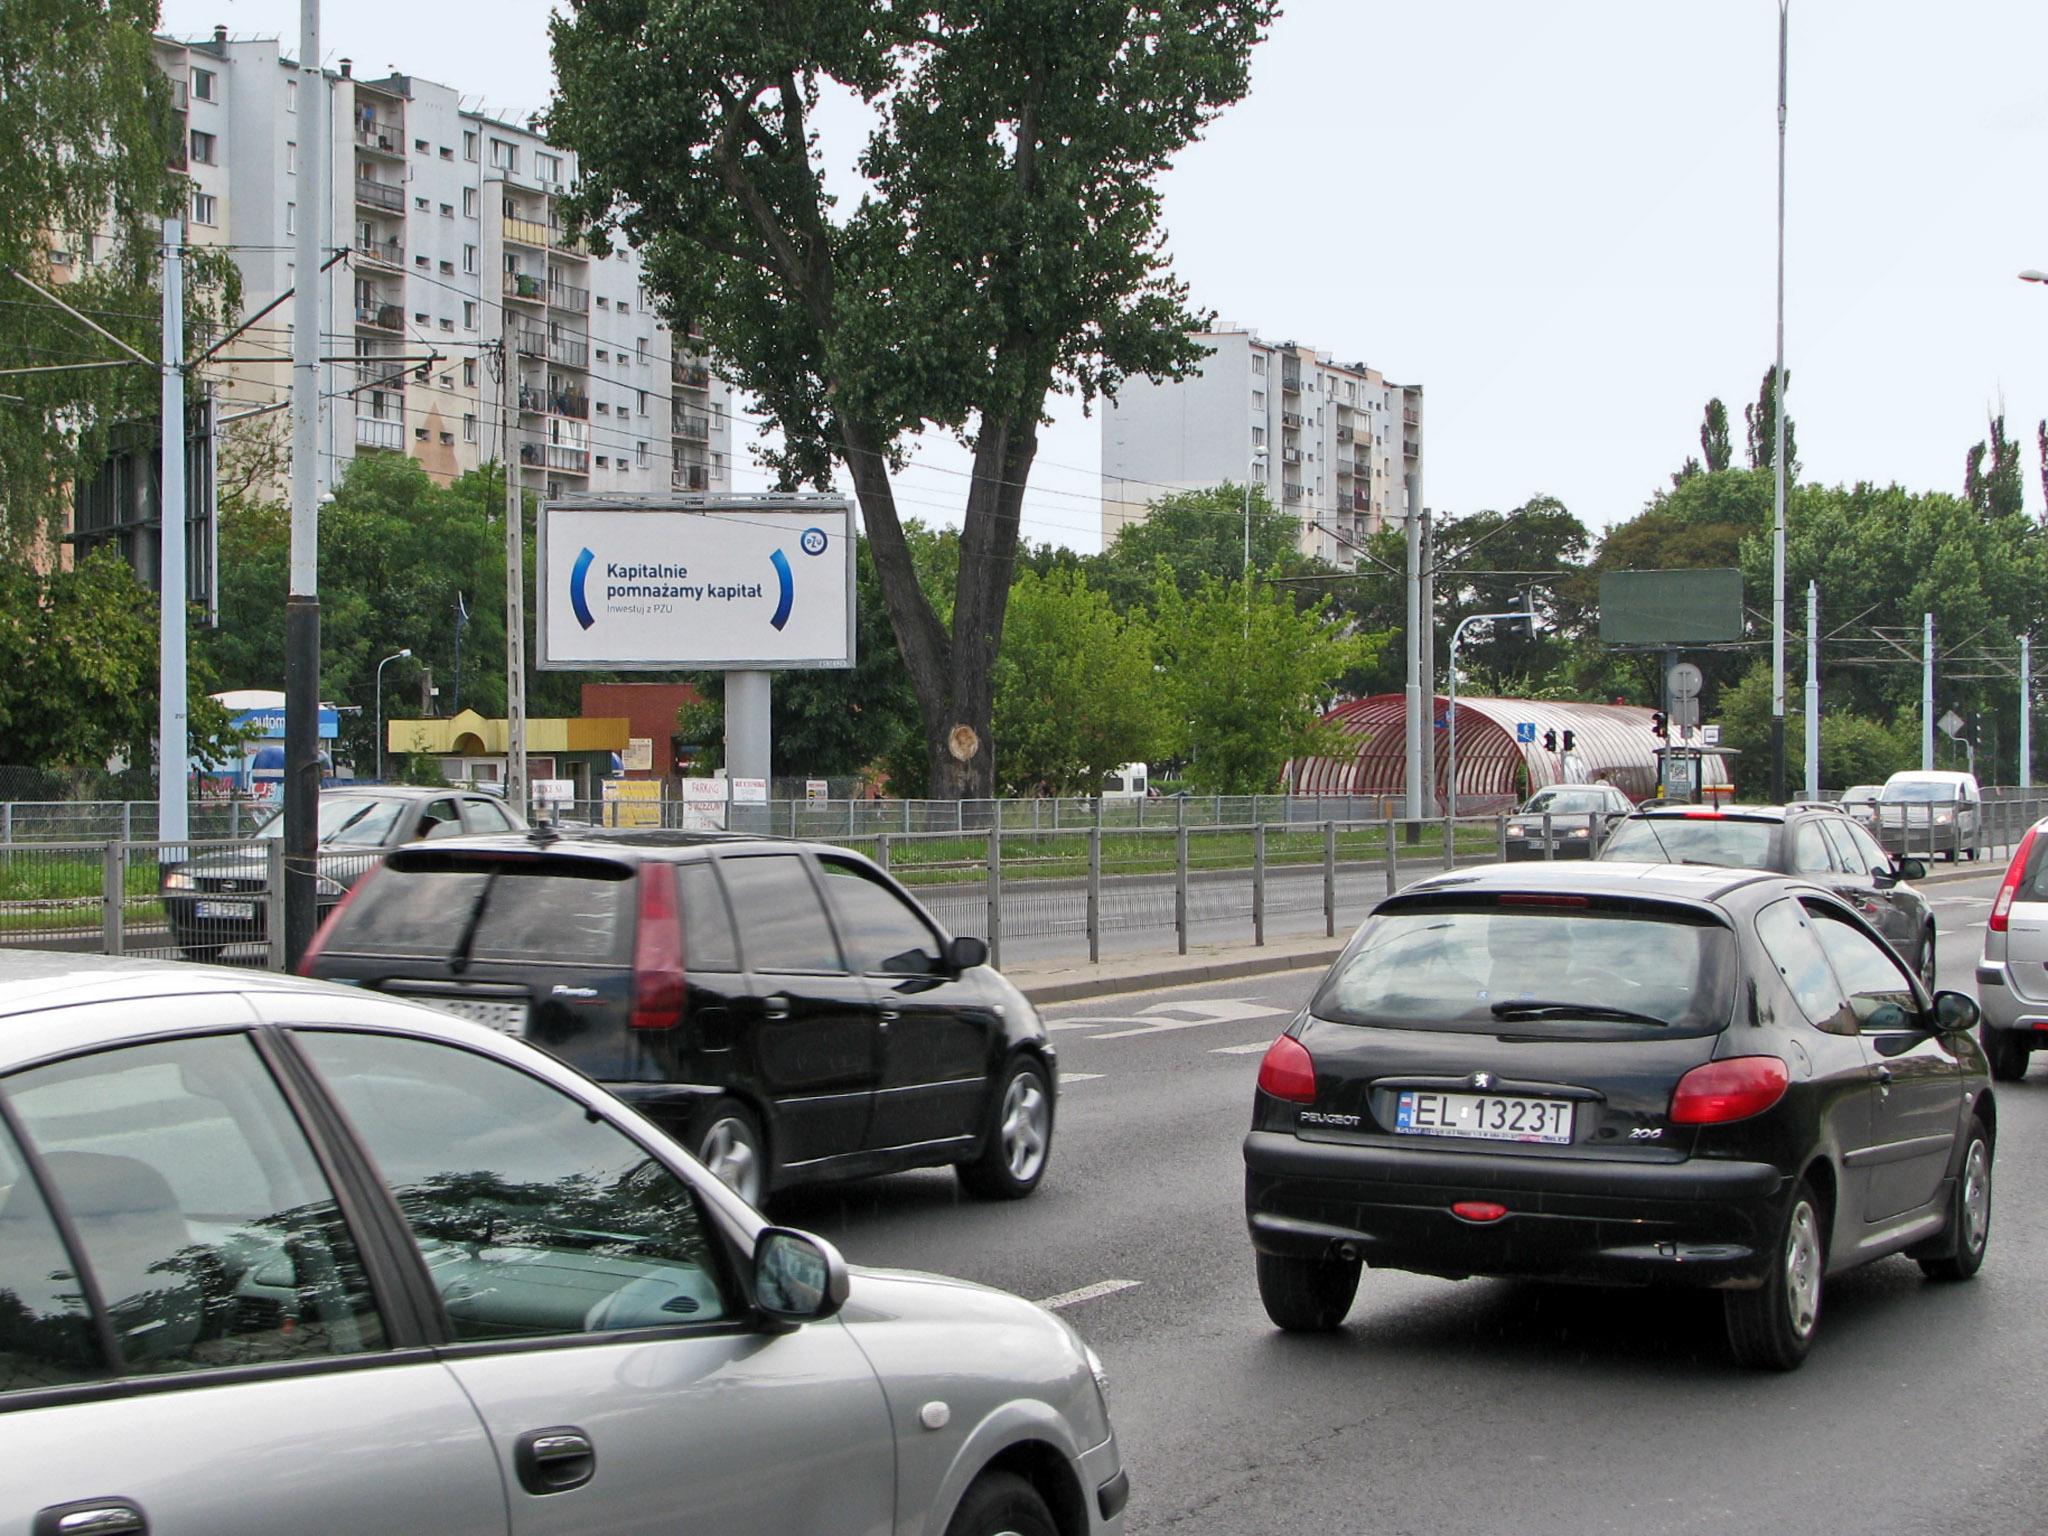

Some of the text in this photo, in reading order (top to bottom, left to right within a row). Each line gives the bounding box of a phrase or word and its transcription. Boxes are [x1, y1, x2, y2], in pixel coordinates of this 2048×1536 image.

[807, 535, 822, 548] PZU
[607, 563, 688, 581] Kapitalnie
[607, 583, 763, 601] pomnażamy kapitał
[607, 604, 645, 615] Inwestuj
[654, 604, 673, 613] PZU
[692, 783, 720, 794] PARKING
[1300, 1111, 1361, 1126] PEUGEOT
[1415, 1095, 1568, 1134] EL 1323T
[1628, 1127, 1663, 1138] 206
